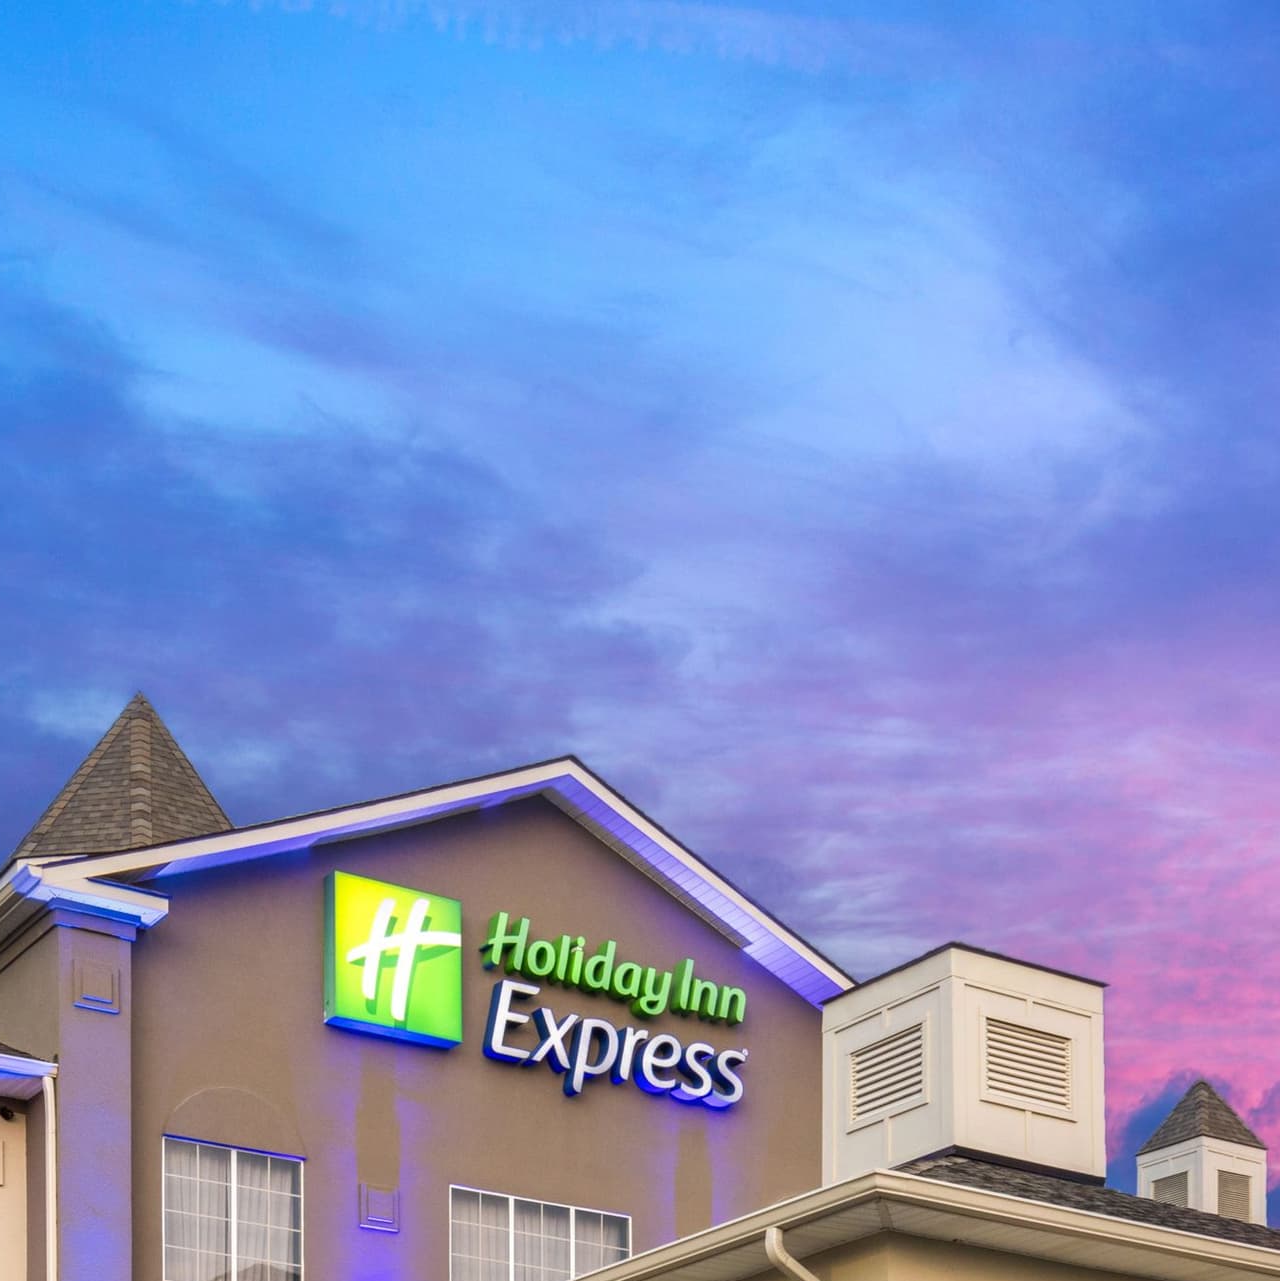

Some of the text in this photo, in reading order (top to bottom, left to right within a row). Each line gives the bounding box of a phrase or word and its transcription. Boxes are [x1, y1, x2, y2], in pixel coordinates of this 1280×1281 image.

[481, 911, 747, 1024] Holiday Inn
[485, 979, 746, 1106] Express
